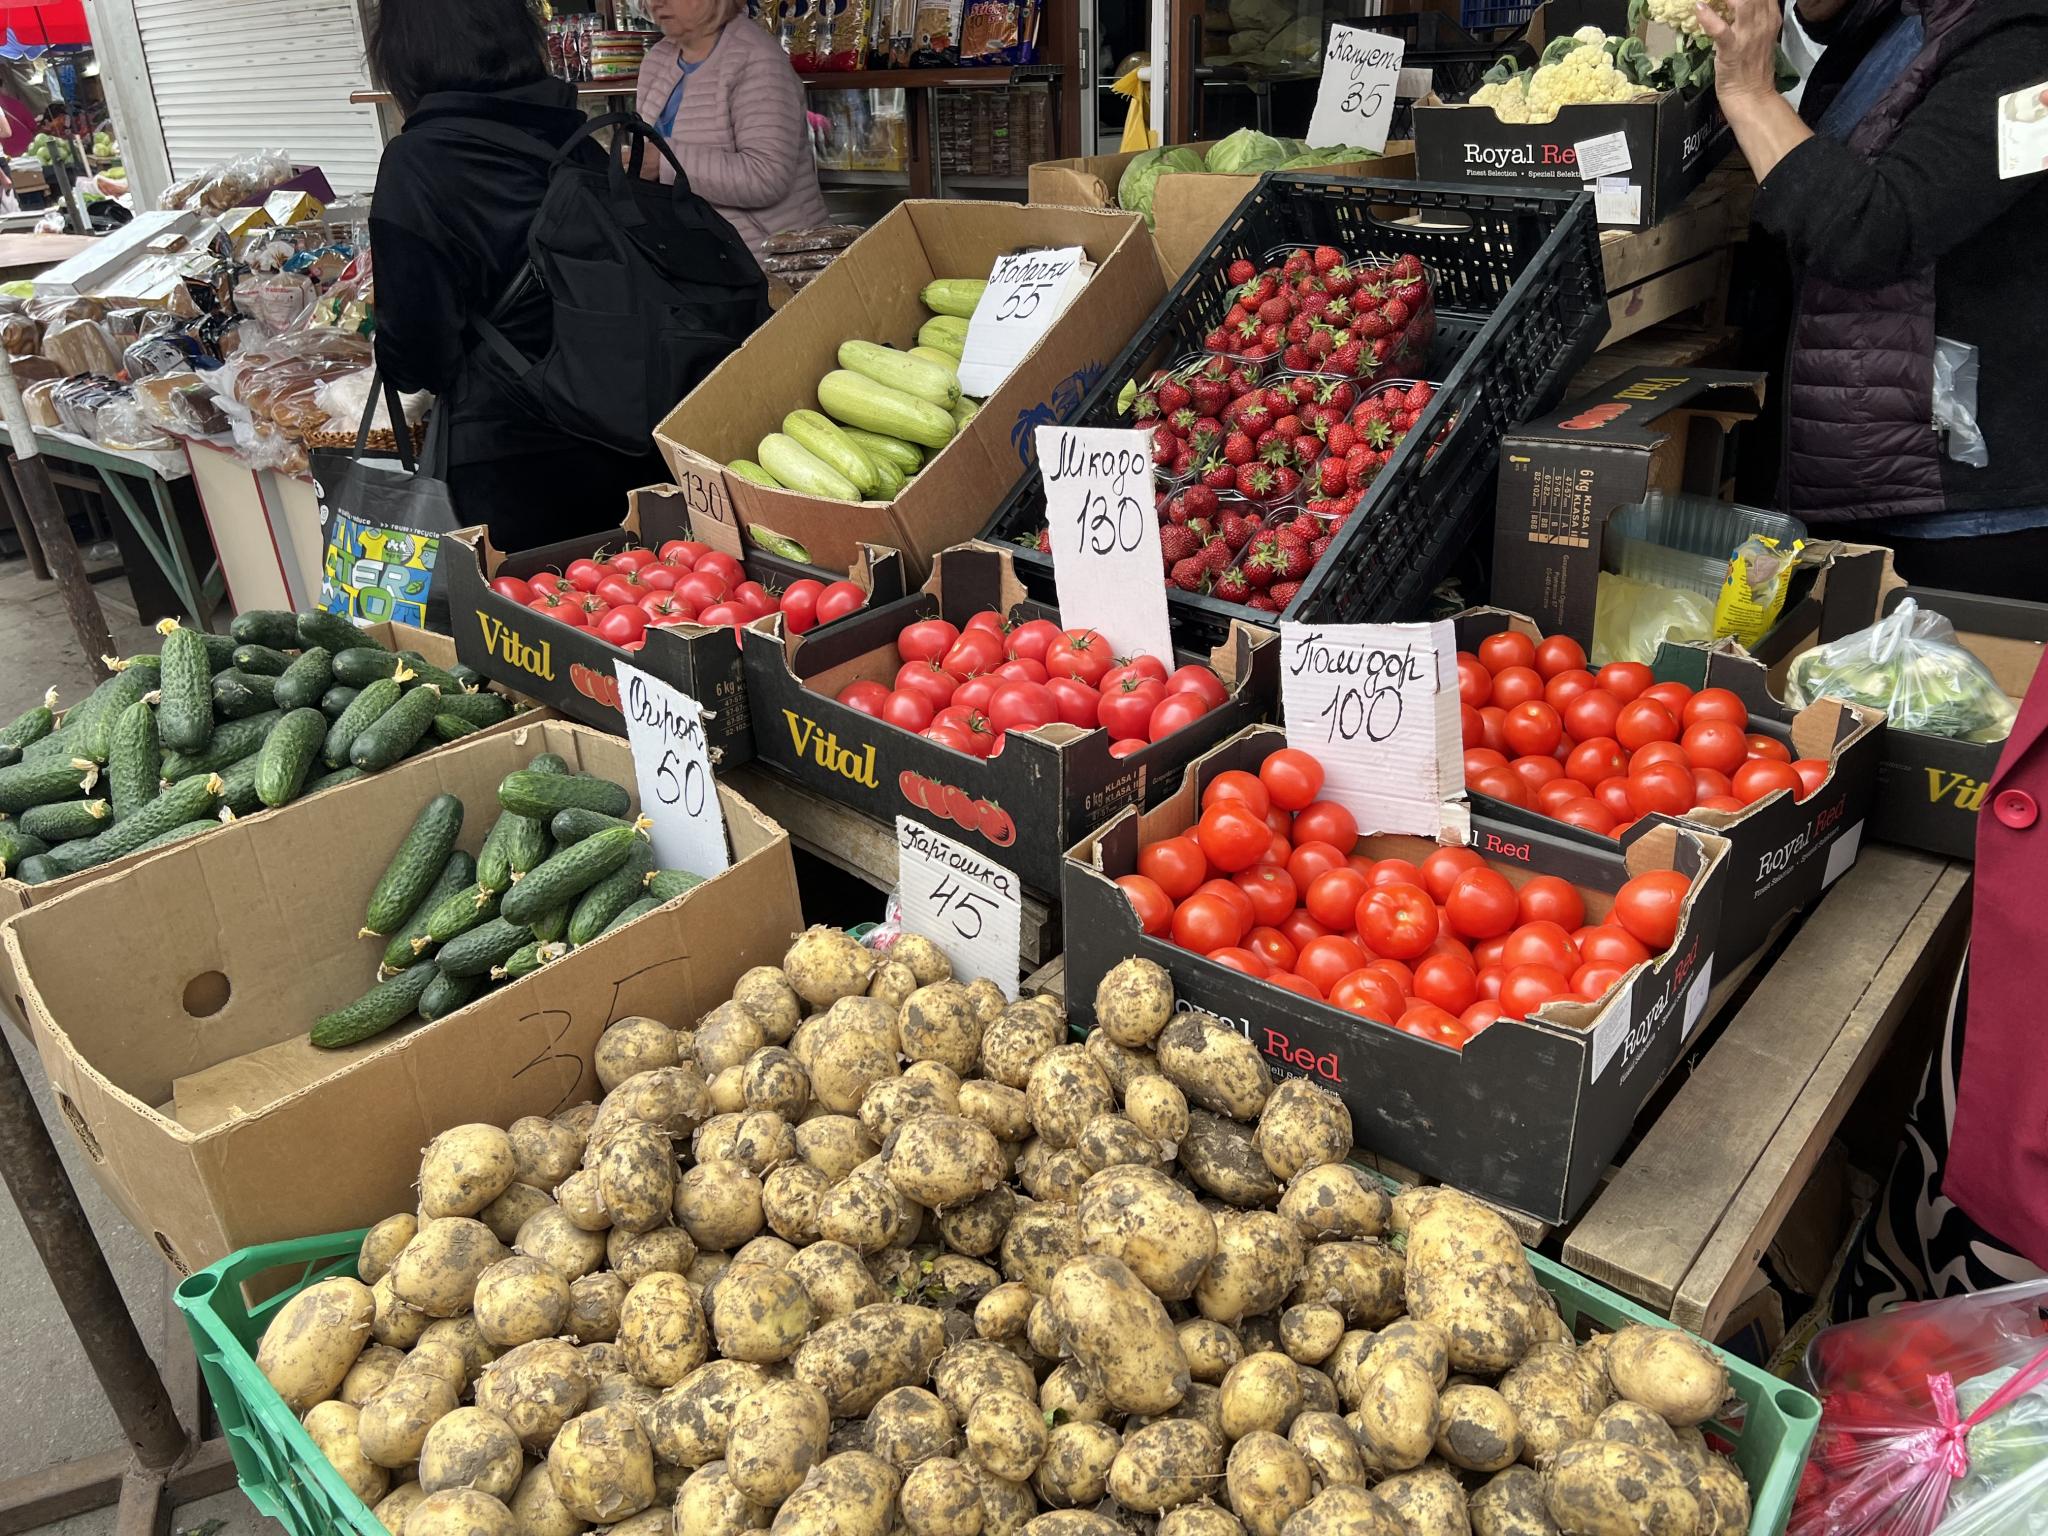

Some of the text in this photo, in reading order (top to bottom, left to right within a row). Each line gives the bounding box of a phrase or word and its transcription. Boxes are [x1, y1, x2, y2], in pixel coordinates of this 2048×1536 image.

[1329, 31, 1402, 80] Капуста
[1341, 82, 1390, 117] 35
[1464, 143, 1535, 168] Royal
[1541, 144, 1577, 165] Re
[989, 253, 1076, 285] Кабачки
[996, 283, 1054, 321] 55
[1613, 377, 1691, 401] Vital
[1050, 431, 1145, 496] Мікадо
[1575, 479, 1593, 492] kg
[1580, 469, 1594, 477] 6
[682, 471, 723, 522] 130
[1571, 494, 1582, 528] KLASA
[1582, 495, 1592, 529] KLASA
[1077, 489, 1144, 555] 130
[476, 610, 555, 682] Vital
[1290, 632, 1424, 698] Помідор
[716, 683, 722, 696] 6
[723, 681, 735, 695] kg
[1321, 685, 1402, 743] 100
[782, 708, 879, 789] Vital
[656, 749, 705, 818] 50
[1085, 795, 1091, 810] 6
[1105, 774, 1131, 793] KLASA
[902, 824, 1015, 900] Картошка
[1486, 833, 1531, 861] Red
[1756, 821, 1812, 882] Royal
[1813, 793, 1847, 839] Red
[929, 874, 999, 939] 45
[1621, 979, 1671, 1067] Royal
[1672, 934, 1699, 994] Red
[1263, 1027, 1342, 1083] Red
